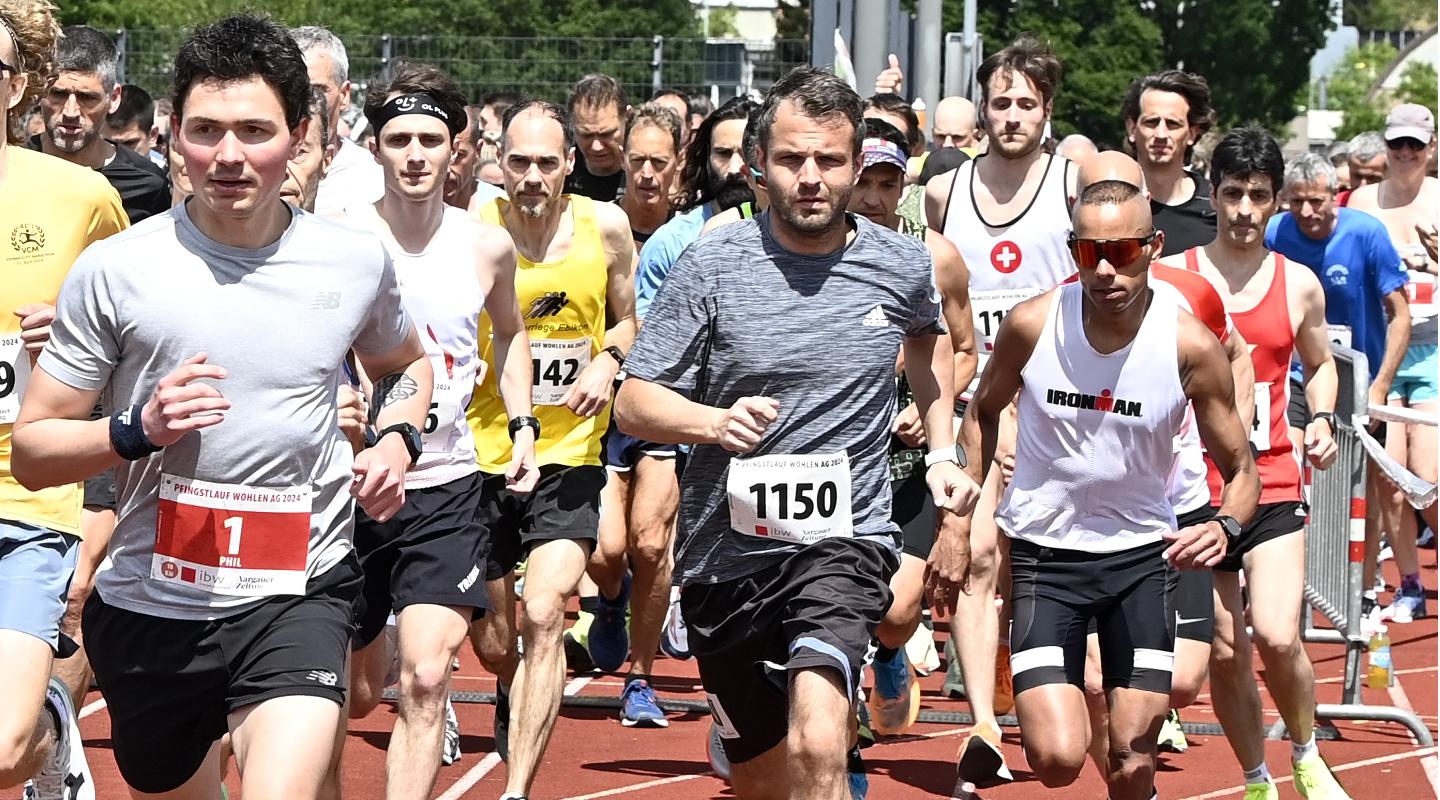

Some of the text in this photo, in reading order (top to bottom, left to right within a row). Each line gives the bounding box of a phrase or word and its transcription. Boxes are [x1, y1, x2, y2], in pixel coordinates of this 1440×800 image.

[558, 323, 589, 332] Ebikon
[2, 338, 18, 346] 2024
[531, 358, 579, 387] 142
[436, 383, 451, 391] 2024
[1046, 388, 1143, 417] IRONMAN
[820, 460, 830, 468] AG
[830, 457, 844, 467] 2024
[173, 483, 301, 503] PFINGSTLAUF WOHLEN AG 2024
[749, 480, 838, 520] 1150
[223, 516, 244, 555] 1
[770, 526, 792, 537] ibw
[219, 555, 242, 567] PHIL
[199, 570, 225, 584] ibw
